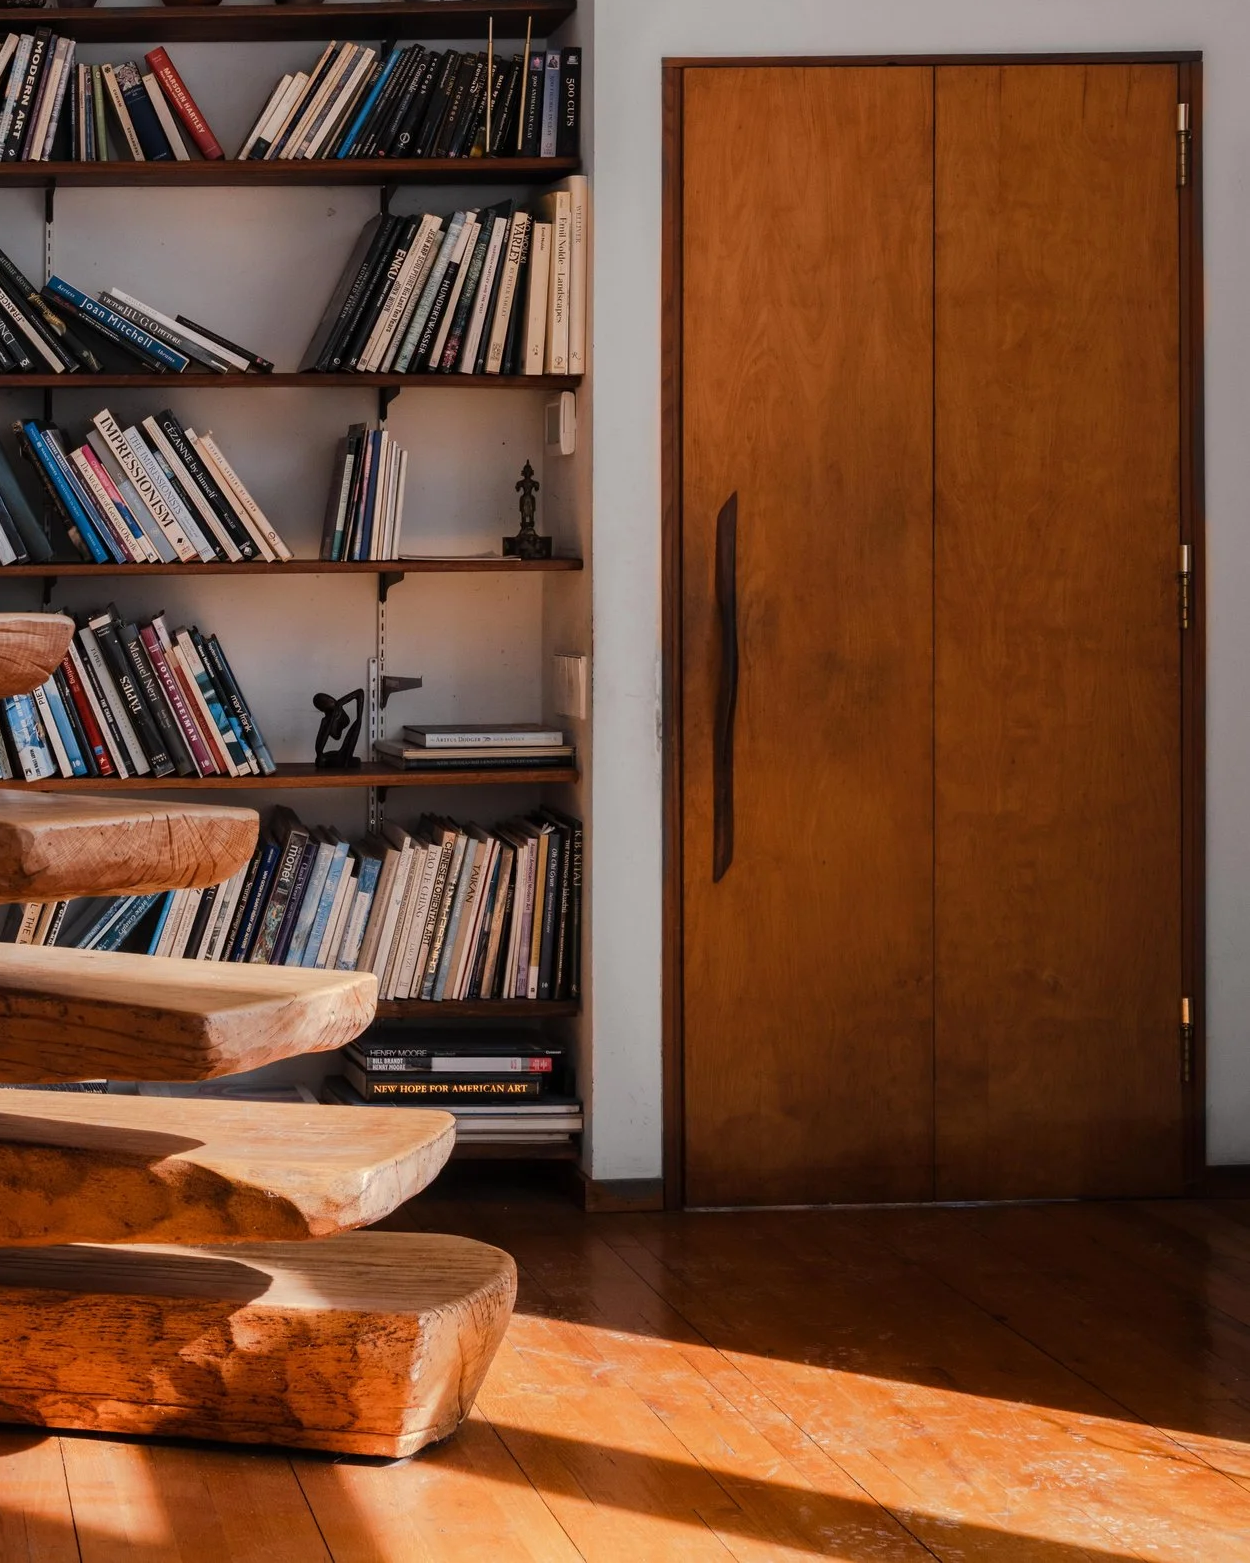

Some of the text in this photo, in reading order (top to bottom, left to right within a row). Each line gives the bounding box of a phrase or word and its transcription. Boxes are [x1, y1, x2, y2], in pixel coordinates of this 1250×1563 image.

[12, 41, 44, 139] MODERN ART
[163, 67, 205, 133] MARSDEN HARTLEY
[567, 101, 575, 126] CUPS
[385, 249, 407, 279] ENKU
[509, 222, 525, 265] VARLEY
[555, 217, 567, 323] Emil Nolde Landscapes
[79, 298, 153, 348] Joan Mitchell
[418, 280, 450, 353] HUNDERTWASSER
[101, 416, 174, 529] IMPRESSIONISM
[163, 422, 217, 499] CÉZANNE by himself
[127, 642, 159, 702] Manuel Neri
[157, 661, 198, 742] JOYCE TREIMAN
[230, 695, 252, 732] mary frank
[280, 845, 298, 882] monet
[466, 865, 482, 903] TAIKAN
[573, 830, 583, 886] R.B. KITAJ
[374, 1084, 528, 1093] NEW HOPE FOR AMERICAN ART
